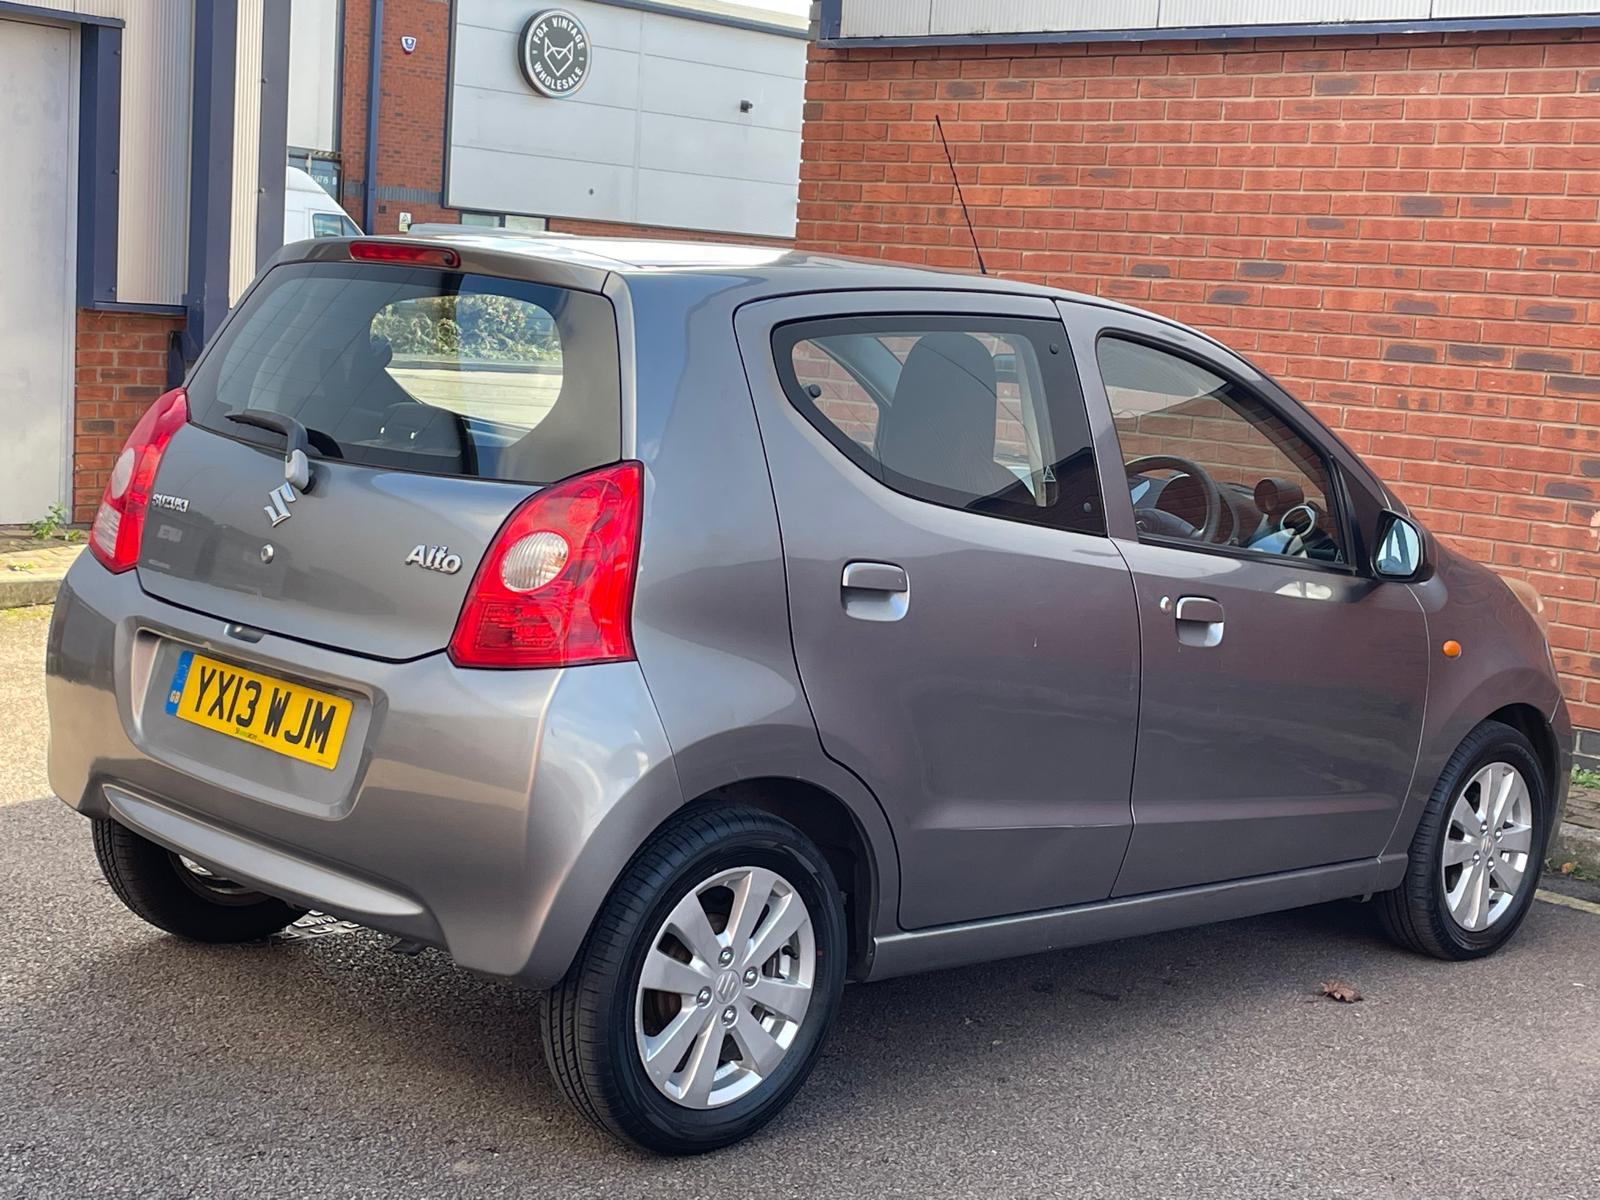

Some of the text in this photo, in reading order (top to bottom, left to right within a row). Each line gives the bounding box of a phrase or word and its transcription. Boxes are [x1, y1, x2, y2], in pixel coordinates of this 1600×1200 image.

[532, 17, 585, 50] FOX VINTAGE
[533, 61, 584, 90] WHOLESALE
[405, 544, 462, 575] Alto
[194, 666, 337, 755] YX13 WJM
